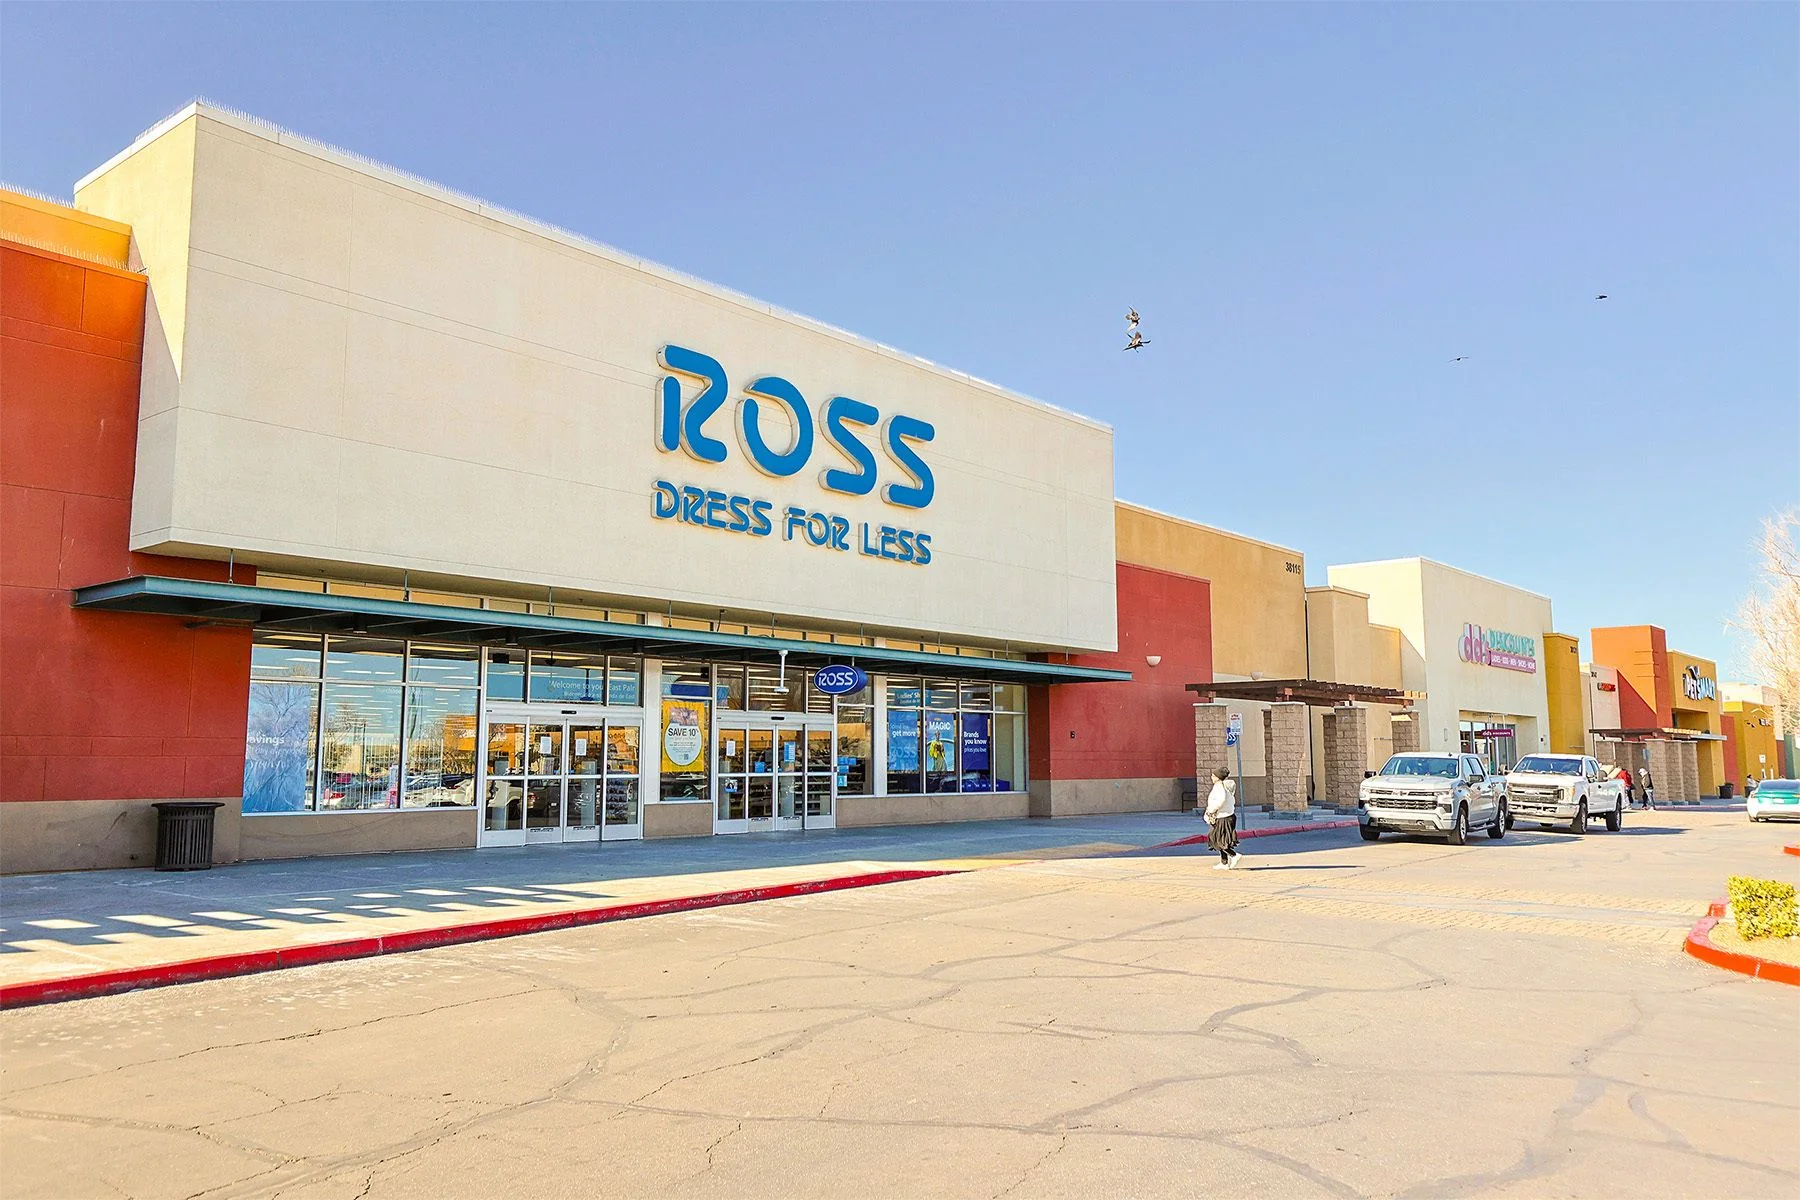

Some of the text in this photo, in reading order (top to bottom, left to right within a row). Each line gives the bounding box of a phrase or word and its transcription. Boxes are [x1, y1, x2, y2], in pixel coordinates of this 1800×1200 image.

[656, 344, 935, 509] ROSS
[652, 480, 932, 565] DRESS FOR LESS
[818, 672, 854, 686] ROSS
[550, 680, 581, 690] Welcome
[929, 721, 951, 731] MAGIC
[668, 727, 688, 737] SAVE
[892, 730, 902, 738] get
